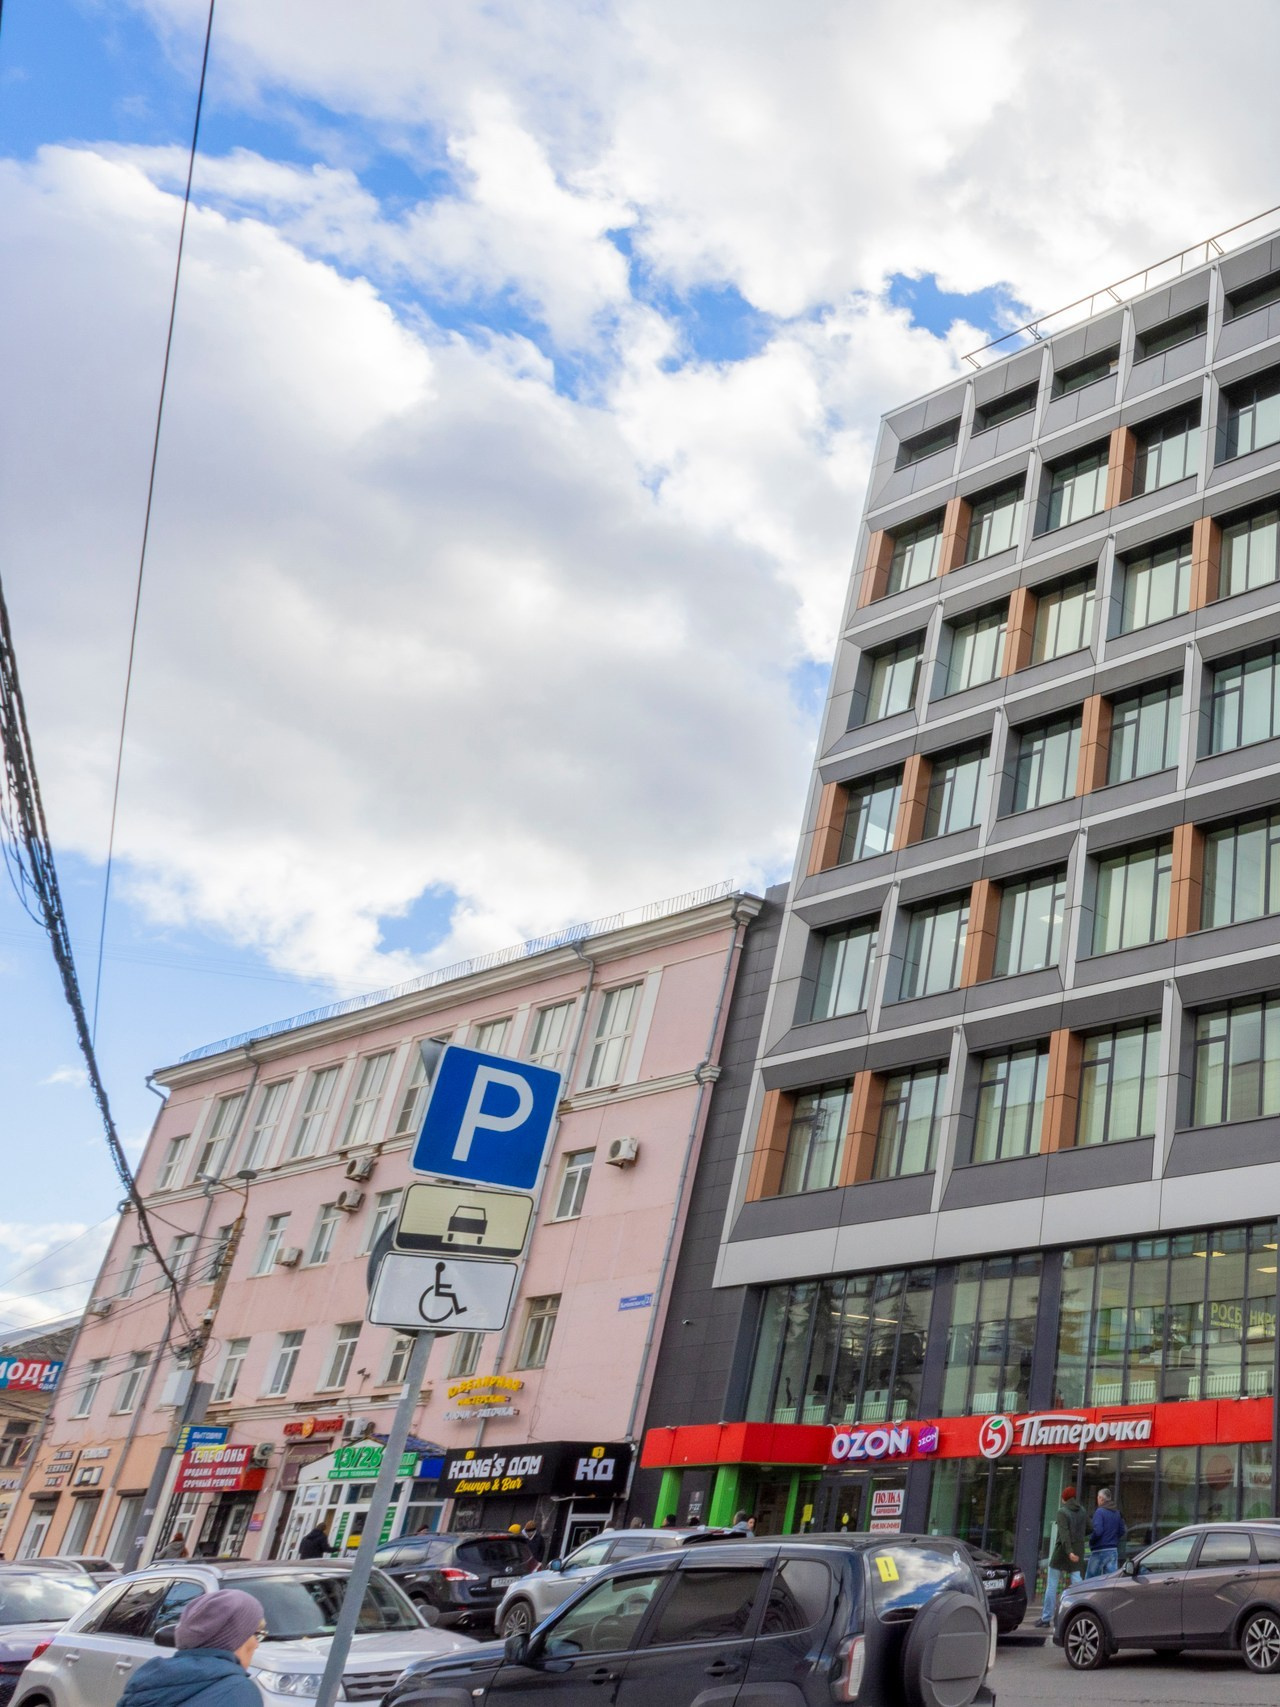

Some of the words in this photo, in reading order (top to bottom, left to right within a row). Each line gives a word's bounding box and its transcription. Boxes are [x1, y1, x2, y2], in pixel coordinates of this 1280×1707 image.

[832, 1429, 909, 1459] OZON
[190, 1448, 248, 1464] ТЕЛЕФОНЫ
[183, 1468, 212, 1477] ПРОДАЖА
[183, 1478, 211, 1488] СРОЧНЫЙ
[212, 1478, 237, 1487] РЕМОНТ
[454, 1478, 491, 1495] Lounge
[491, 1479, 500, 1490] &
[501, 1476, 524, 1492] Bar
[875, 1492, 901, 1504] ПОЛКА
